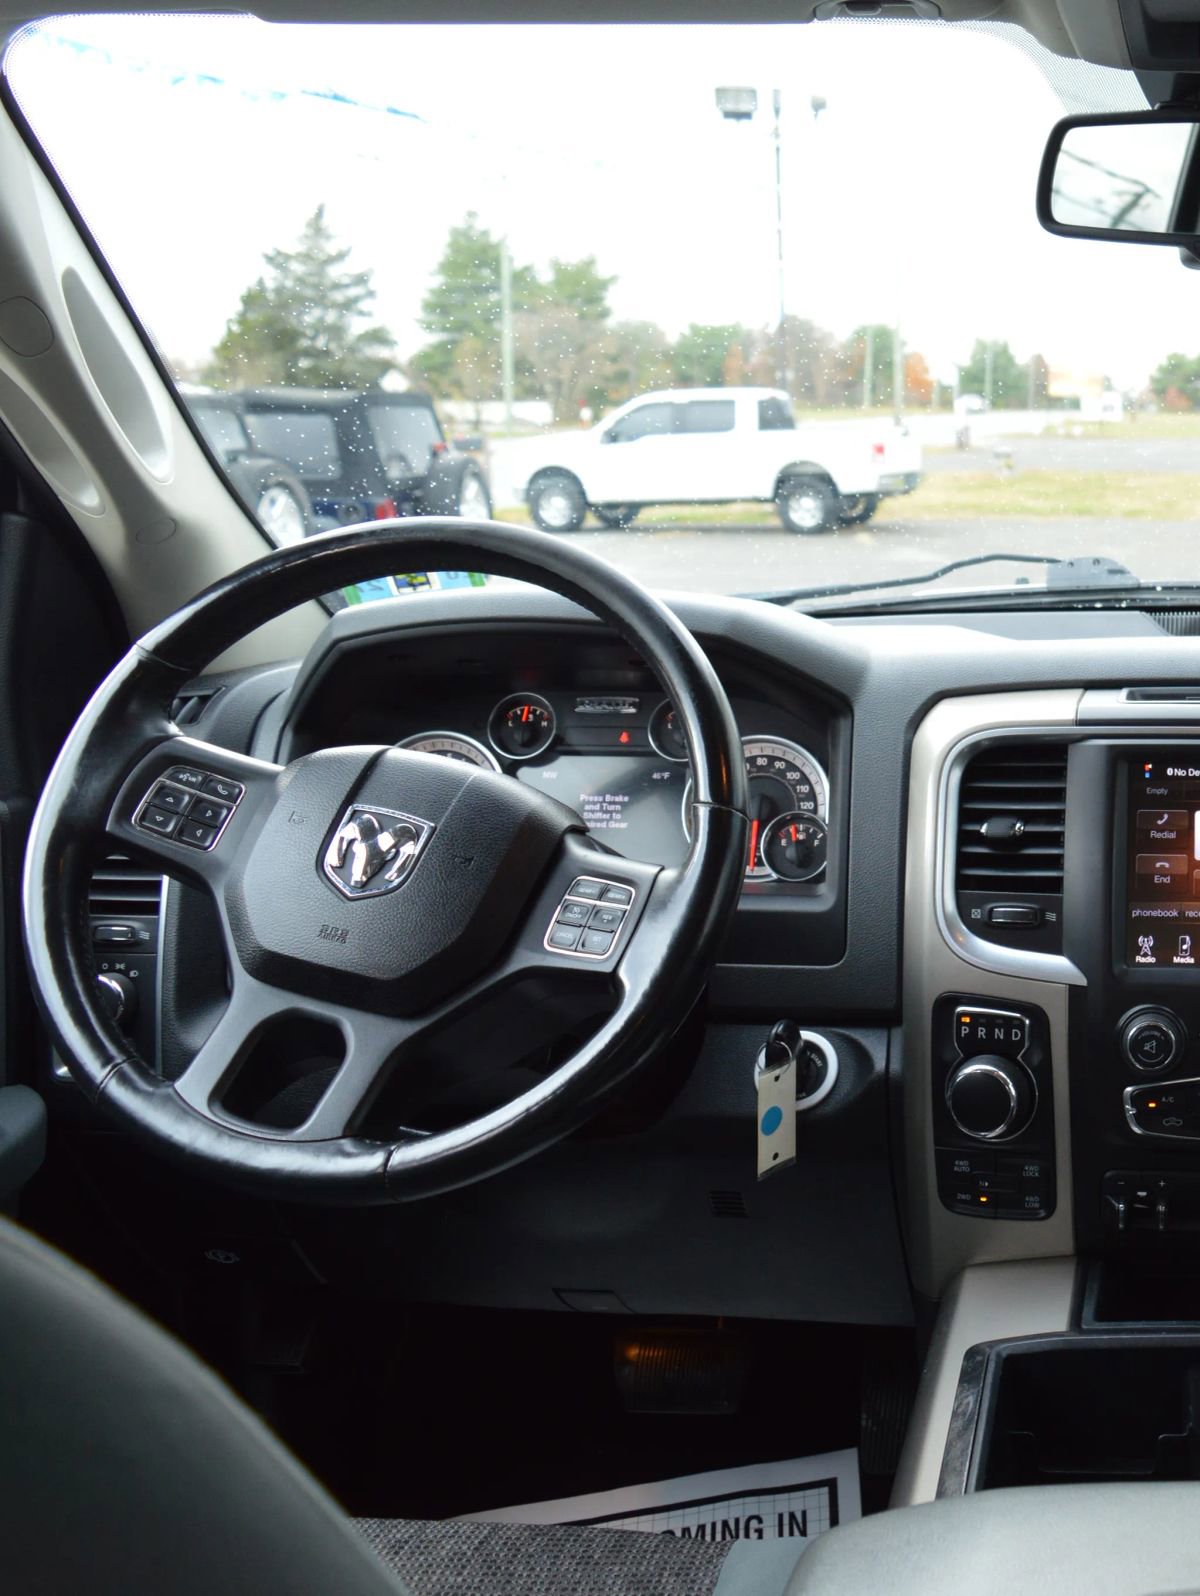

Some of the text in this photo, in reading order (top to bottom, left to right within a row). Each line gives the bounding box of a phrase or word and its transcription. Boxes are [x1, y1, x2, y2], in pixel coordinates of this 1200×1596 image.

[756, 757, 768, 766] 80
[774, 761, 786, 769] 90
[785, 771, 800, 780] 100
[1174, 768, 1187, 777] No
[796, 785, 810, 793] 110
[1146, 787, 1169, 796] Empty
[579, 793, 630, 803] Press Brake
[584, 803, 622, 811] and Turn
[799, 801, 814, 810] 120
[582, 811, 622, 820] Shifter to
[586, 820, 629, 829] sired Gear
[1150, 831, 1177, 840] Redial
[814, 839, 820, 847] F
[1153, 874, 1171, 884] End
[1131, 909, 1179, 918] phonebook
[1135, 955, 1156, 963] Radio
[1173, 956, 1195, 964] Media
[961, 1026, 1021, 1041] P R N D
[777, 1509, 808, 1538] IN
